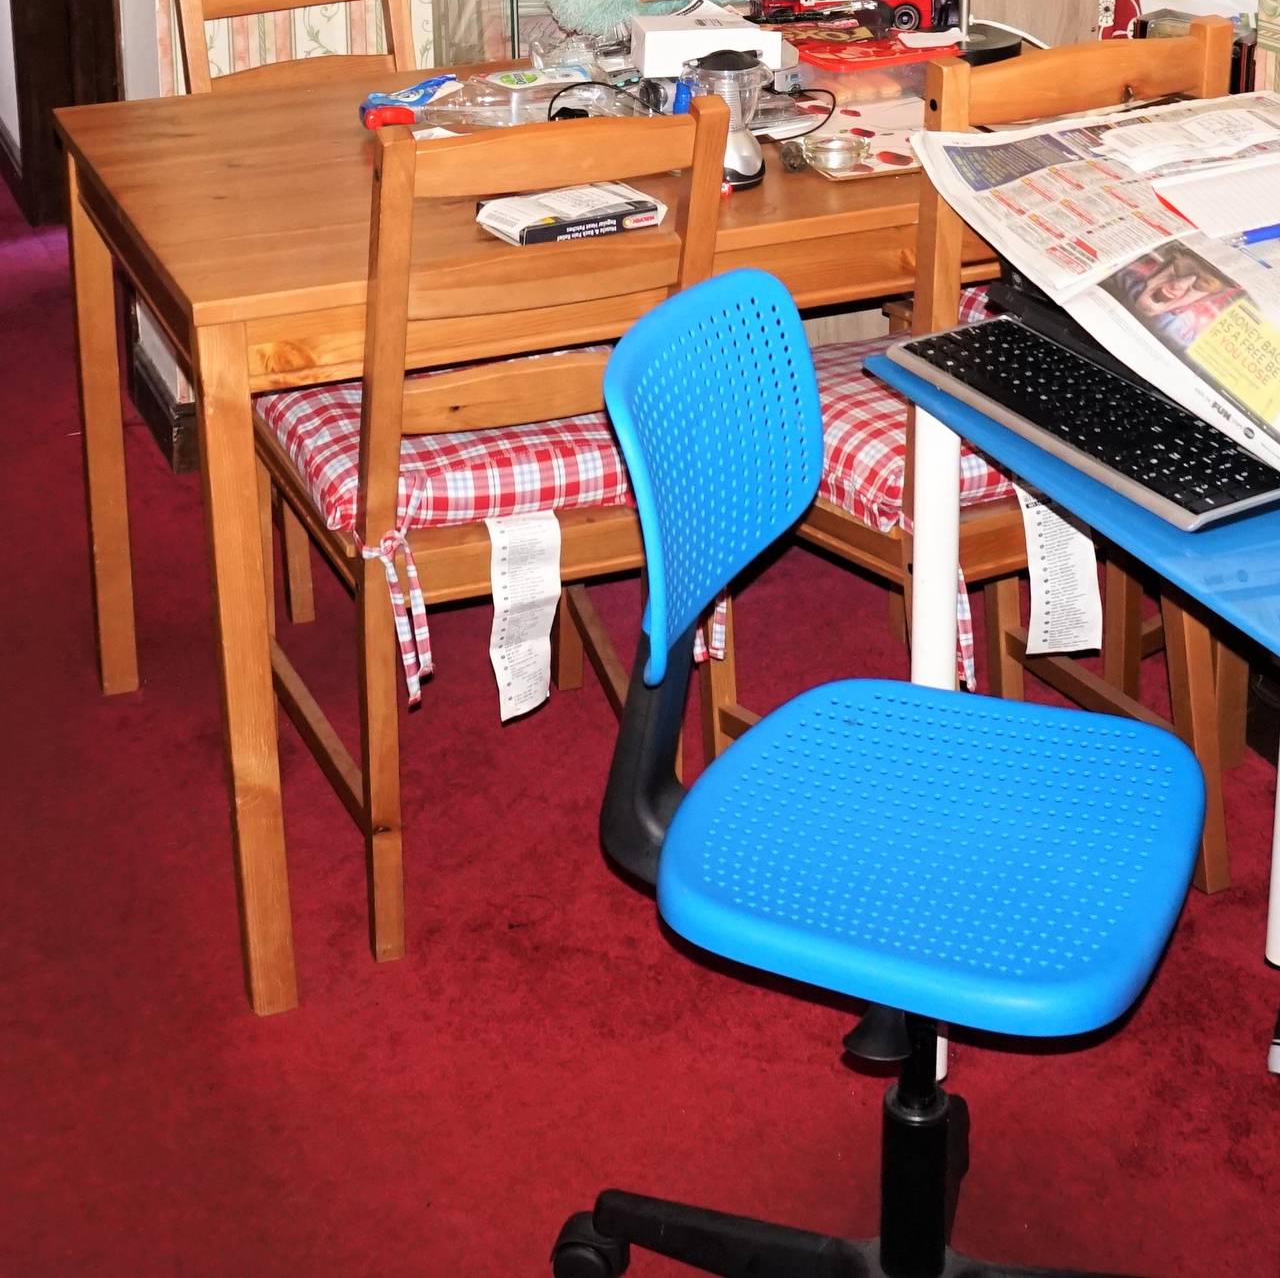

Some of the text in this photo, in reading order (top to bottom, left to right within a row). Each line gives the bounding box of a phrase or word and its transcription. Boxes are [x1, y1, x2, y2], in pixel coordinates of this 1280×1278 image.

[583, 229, 595, 237] Back
[599, 224, 617, 234] Muscle
[1228, 310, 1264, 343] MONEY
[1219, 319, 1233, 334] AS
[1241, 338, 1266, 365] FREE
[1219, 337, 1242, 361] YOU
[1241, 357, 1271, 387] LOSE
[1211, 401, 1232, 421] FUN
